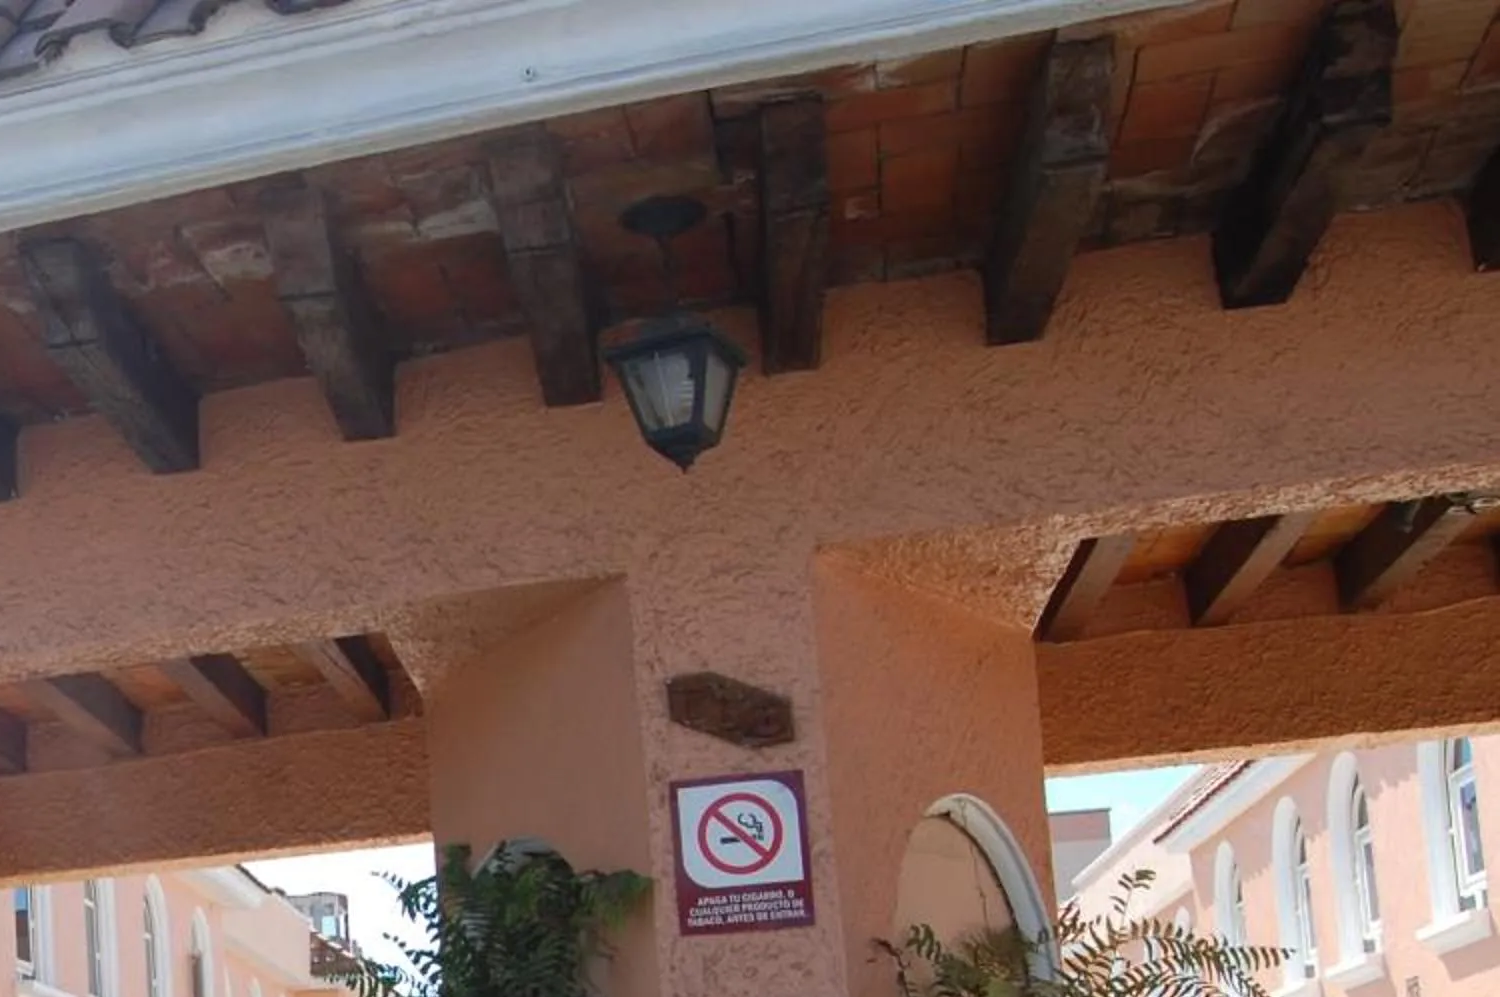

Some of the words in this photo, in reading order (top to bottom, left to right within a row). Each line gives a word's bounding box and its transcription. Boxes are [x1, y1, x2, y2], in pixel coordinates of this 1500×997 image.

[729, 894, 740, 905] TU
[689, 904, 740, 917] CUALQUIER
[742, 900, 790, 912] PRODUCTO
[792, 898, 804, 908] DE
[727, 913, 755, 924] ANTES
[756, 911, 768, 921] DE
